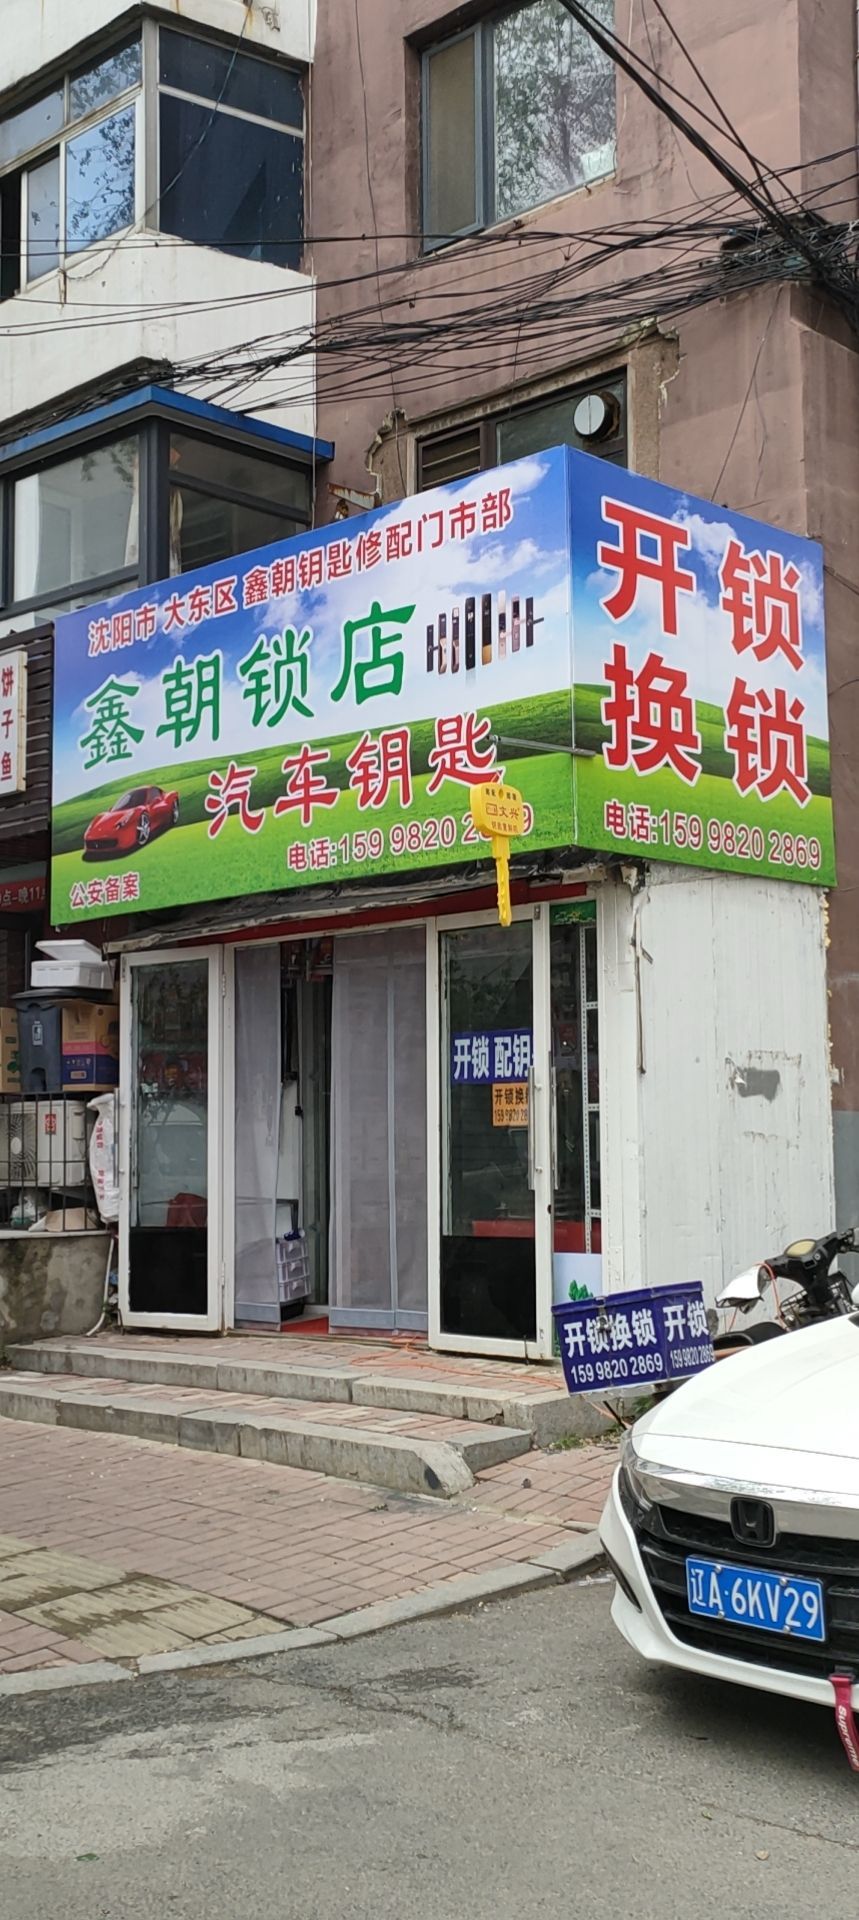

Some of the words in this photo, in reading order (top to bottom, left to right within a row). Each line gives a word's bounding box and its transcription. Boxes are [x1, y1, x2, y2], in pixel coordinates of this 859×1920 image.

[88, 606, 157, 656] 沈阳市
[164, 576, 236, 628] 大东区
[244, 488, 513, 606] 鑫朝钥匙修配门市部
[600, 499, 803, 669] 开锁
[80, 602, 416, 770] 鑫朝锁店
[604, 644, 810, 806] 换锁
[206, 712, 502, 836] 汽车钥匙
[391, 819, 456, 854] 9820
[708, 821, 764, 861] 9820
[769, 832, 821, 869] 2869
[70, 873, 139, 908] 公安备案
[454, 1037, 490, 1079] 开锁
[494, 1036, 534, 1078] 配钥
[494, 1087, 528, 1105] 开锁换
[563, 1308, 657, 1359] 开锁换锁
[571, 1364, 594, 1384] 159
[595, 1359, 628, 1380] 9820
[631, 1352, 663, 1374] 2869
